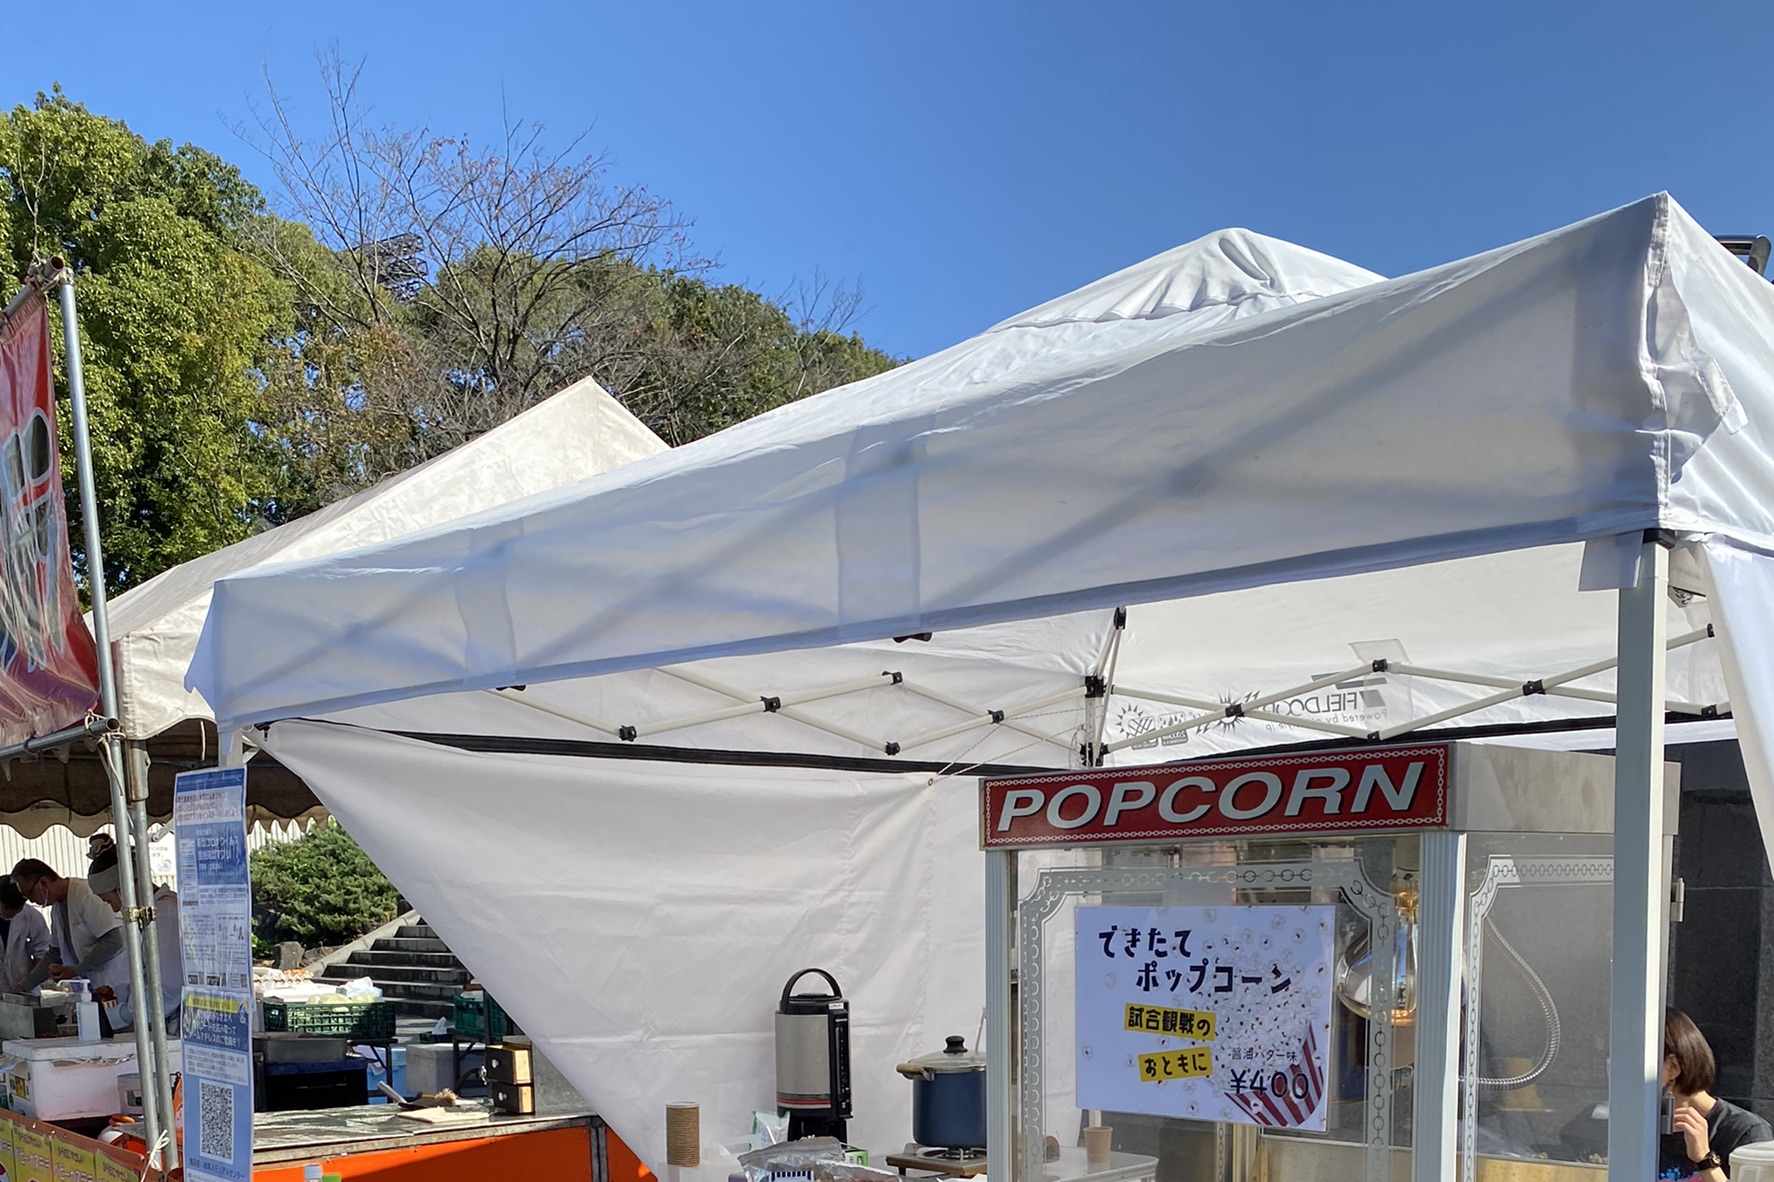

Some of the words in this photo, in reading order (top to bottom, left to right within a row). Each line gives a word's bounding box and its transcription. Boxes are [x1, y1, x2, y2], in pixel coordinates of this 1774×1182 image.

[998, 762, 1425, 831] POPCORN
[1099, 926, 1192, 958] できたて
[1136, 960, 1291, 994] ポップコーン
[1127, 1006, 1211, 1037] 試合観戦の
[1144, 1055, 1207, 1077] おともに
[1230, 1069, 1309, 1099] ¥400
